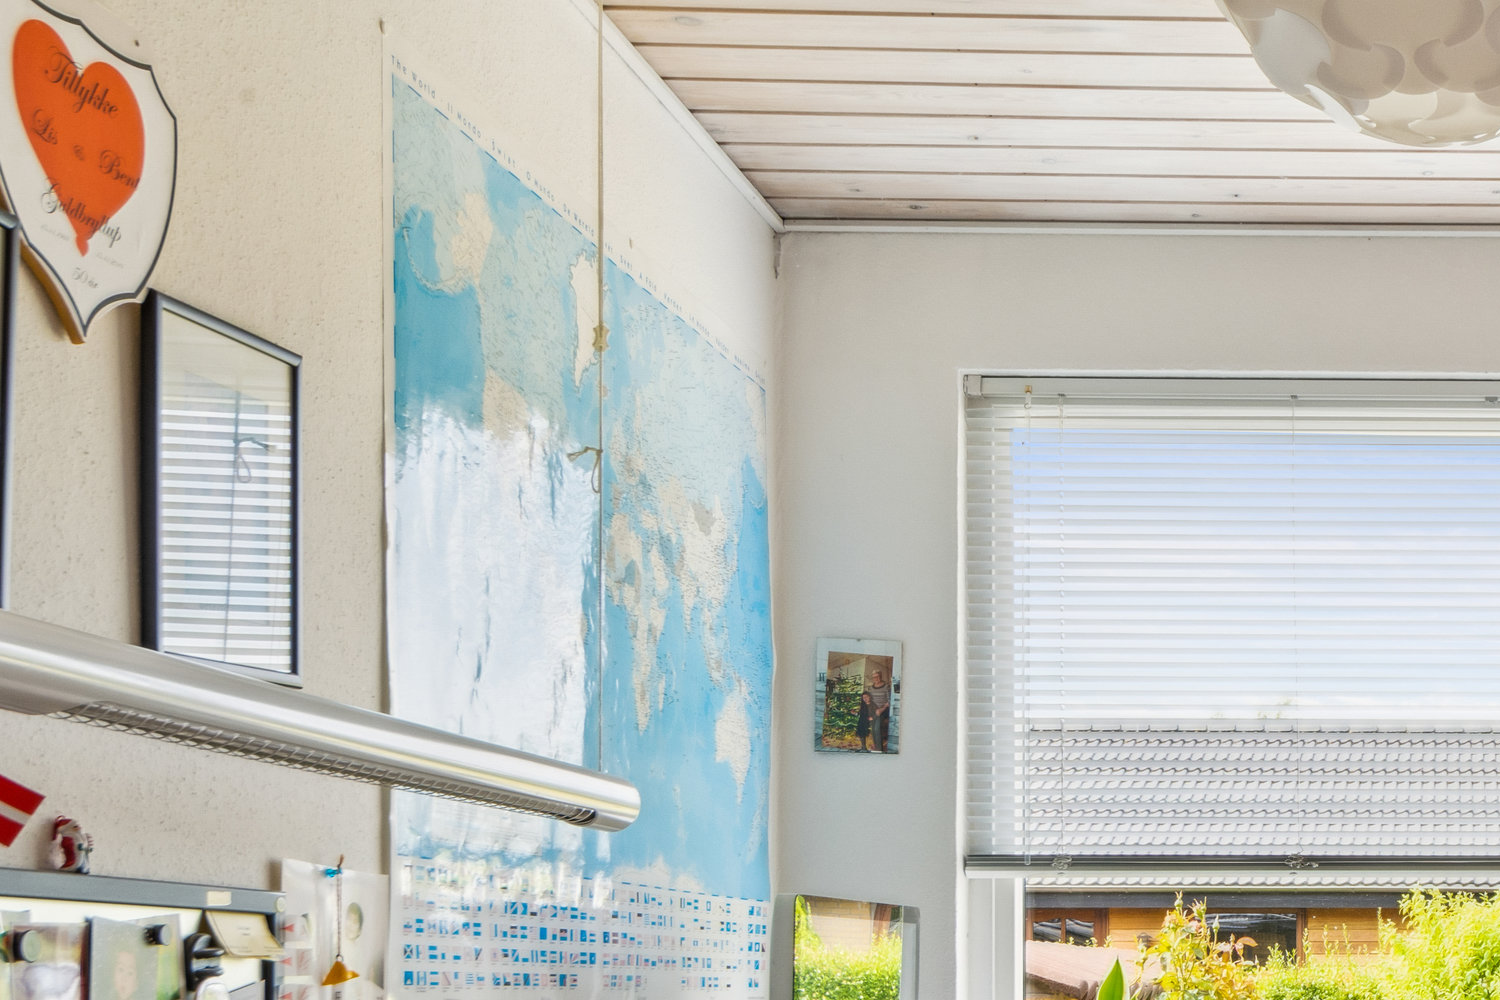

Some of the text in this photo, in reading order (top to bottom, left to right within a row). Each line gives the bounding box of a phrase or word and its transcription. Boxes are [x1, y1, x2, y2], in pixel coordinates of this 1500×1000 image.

[43, 45, 119, 119] Tillykke
[391, 54, 407, 75] The
[412, 71, 436, 99] World
[98, 150, 140, 189] Bent
[40, 176, 122, 249] Guldbryllup
